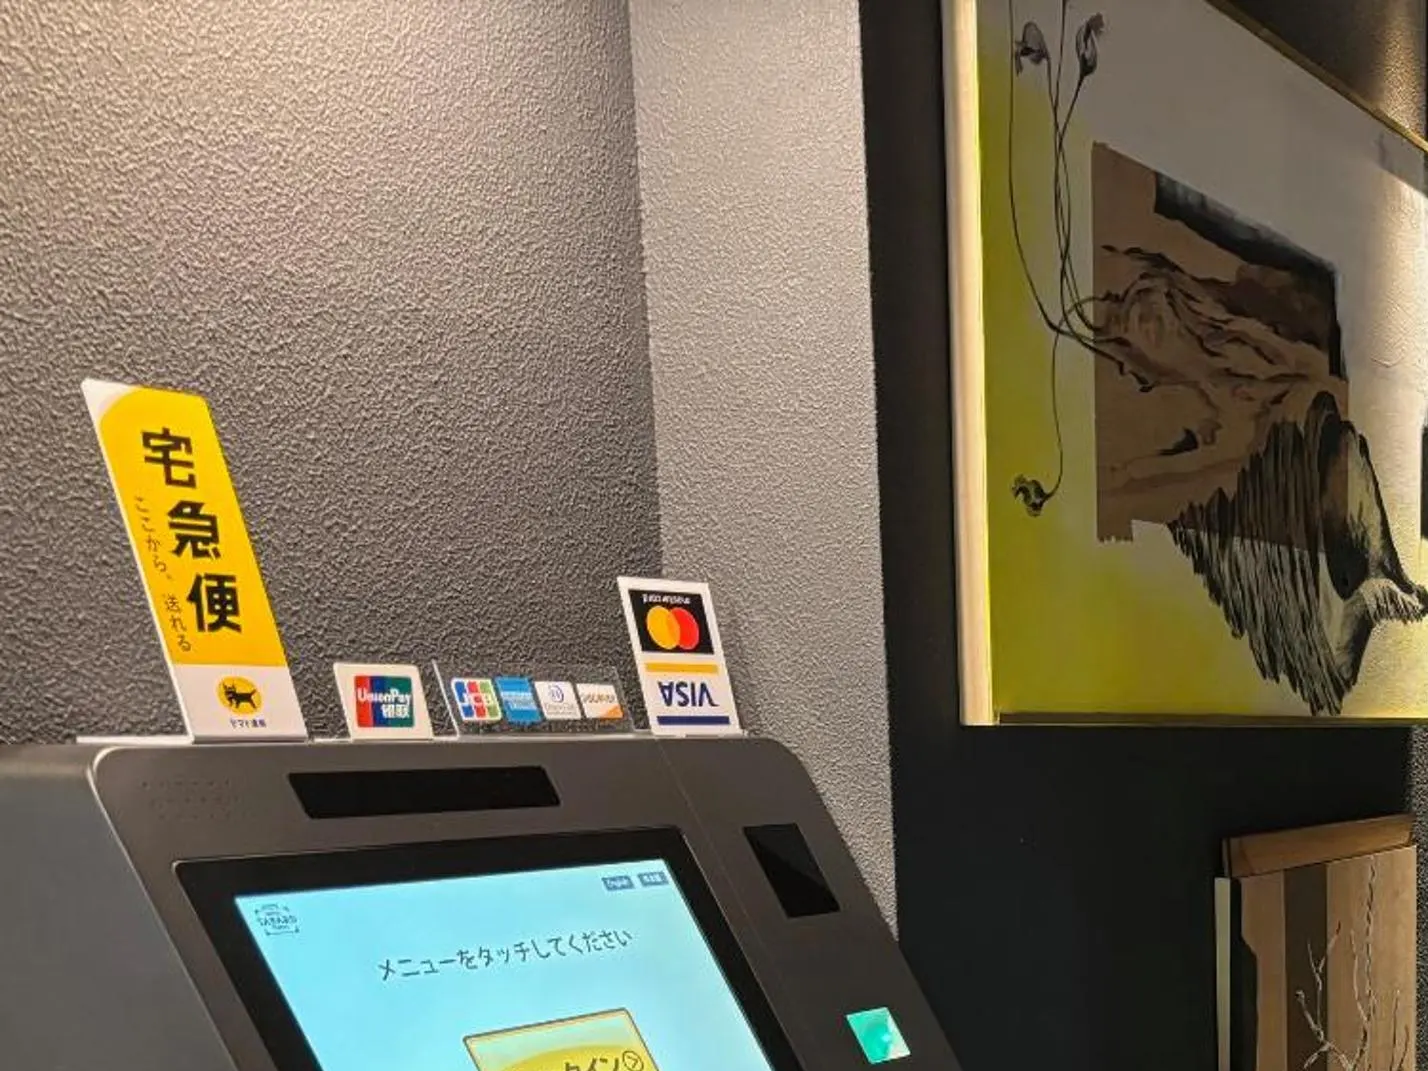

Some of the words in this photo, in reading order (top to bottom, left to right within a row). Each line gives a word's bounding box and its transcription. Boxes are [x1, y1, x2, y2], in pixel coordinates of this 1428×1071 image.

[140, 427, 243, 634] 宅急便
[357, 687, 411, 706] UnionPay
[658, 681, 720, 707] VISA
[378, 929, 633, 981] メニューをタッチしてください
